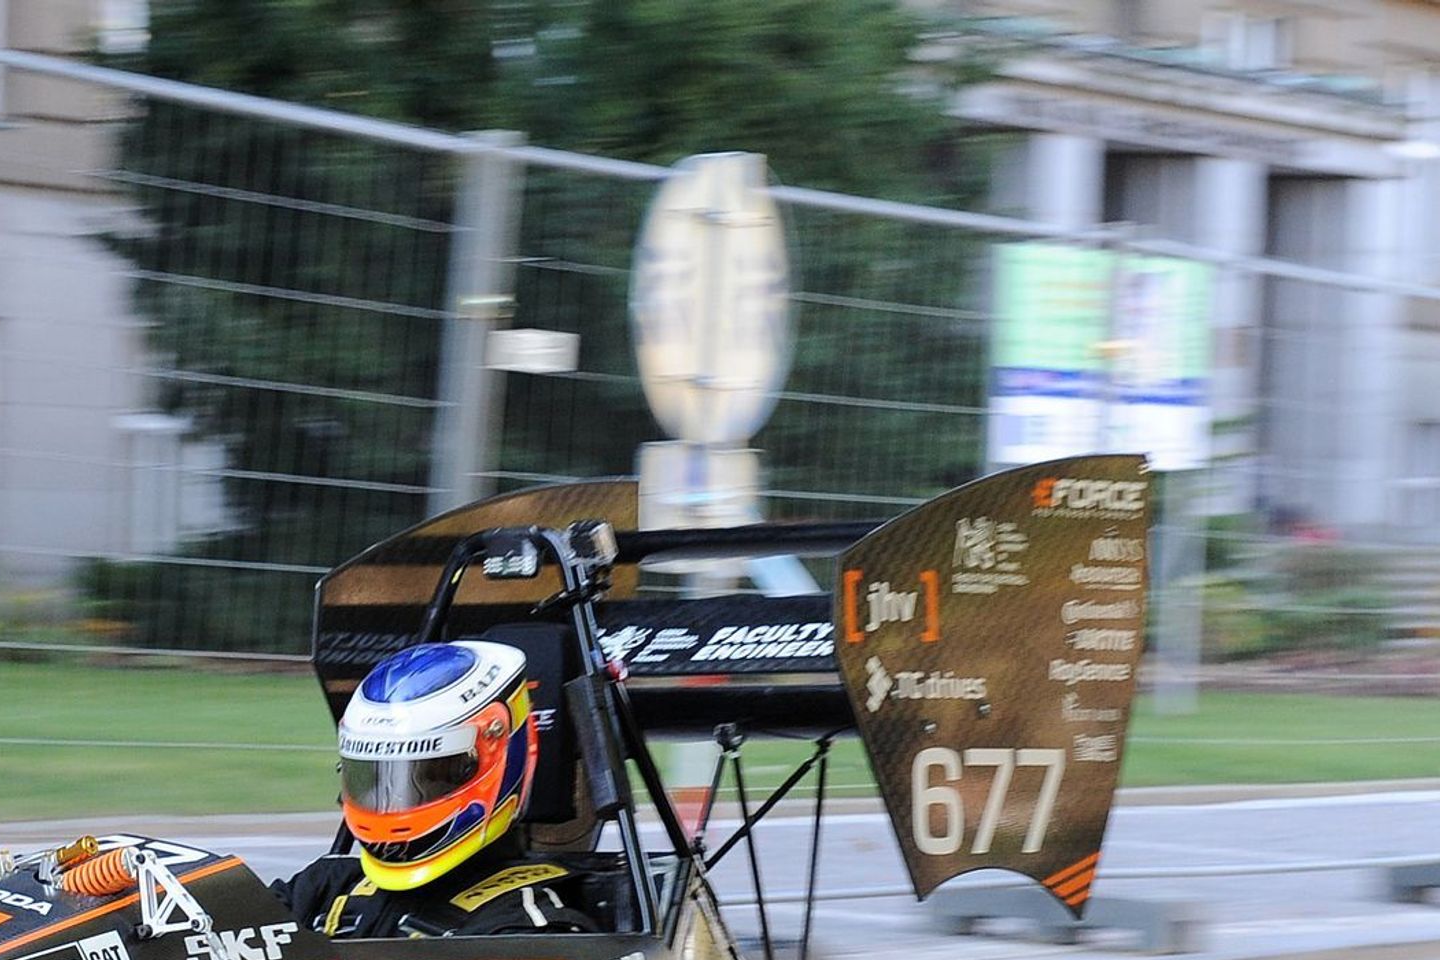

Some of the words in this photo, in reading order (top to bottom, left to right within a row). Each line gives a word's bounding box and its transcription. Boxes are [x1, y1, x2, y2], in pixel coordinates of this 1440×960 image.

[865, 581, 918, 632] jhv
[707, 622, 835, 645] FACULTY
[912, 747, 1066, 855] 677
